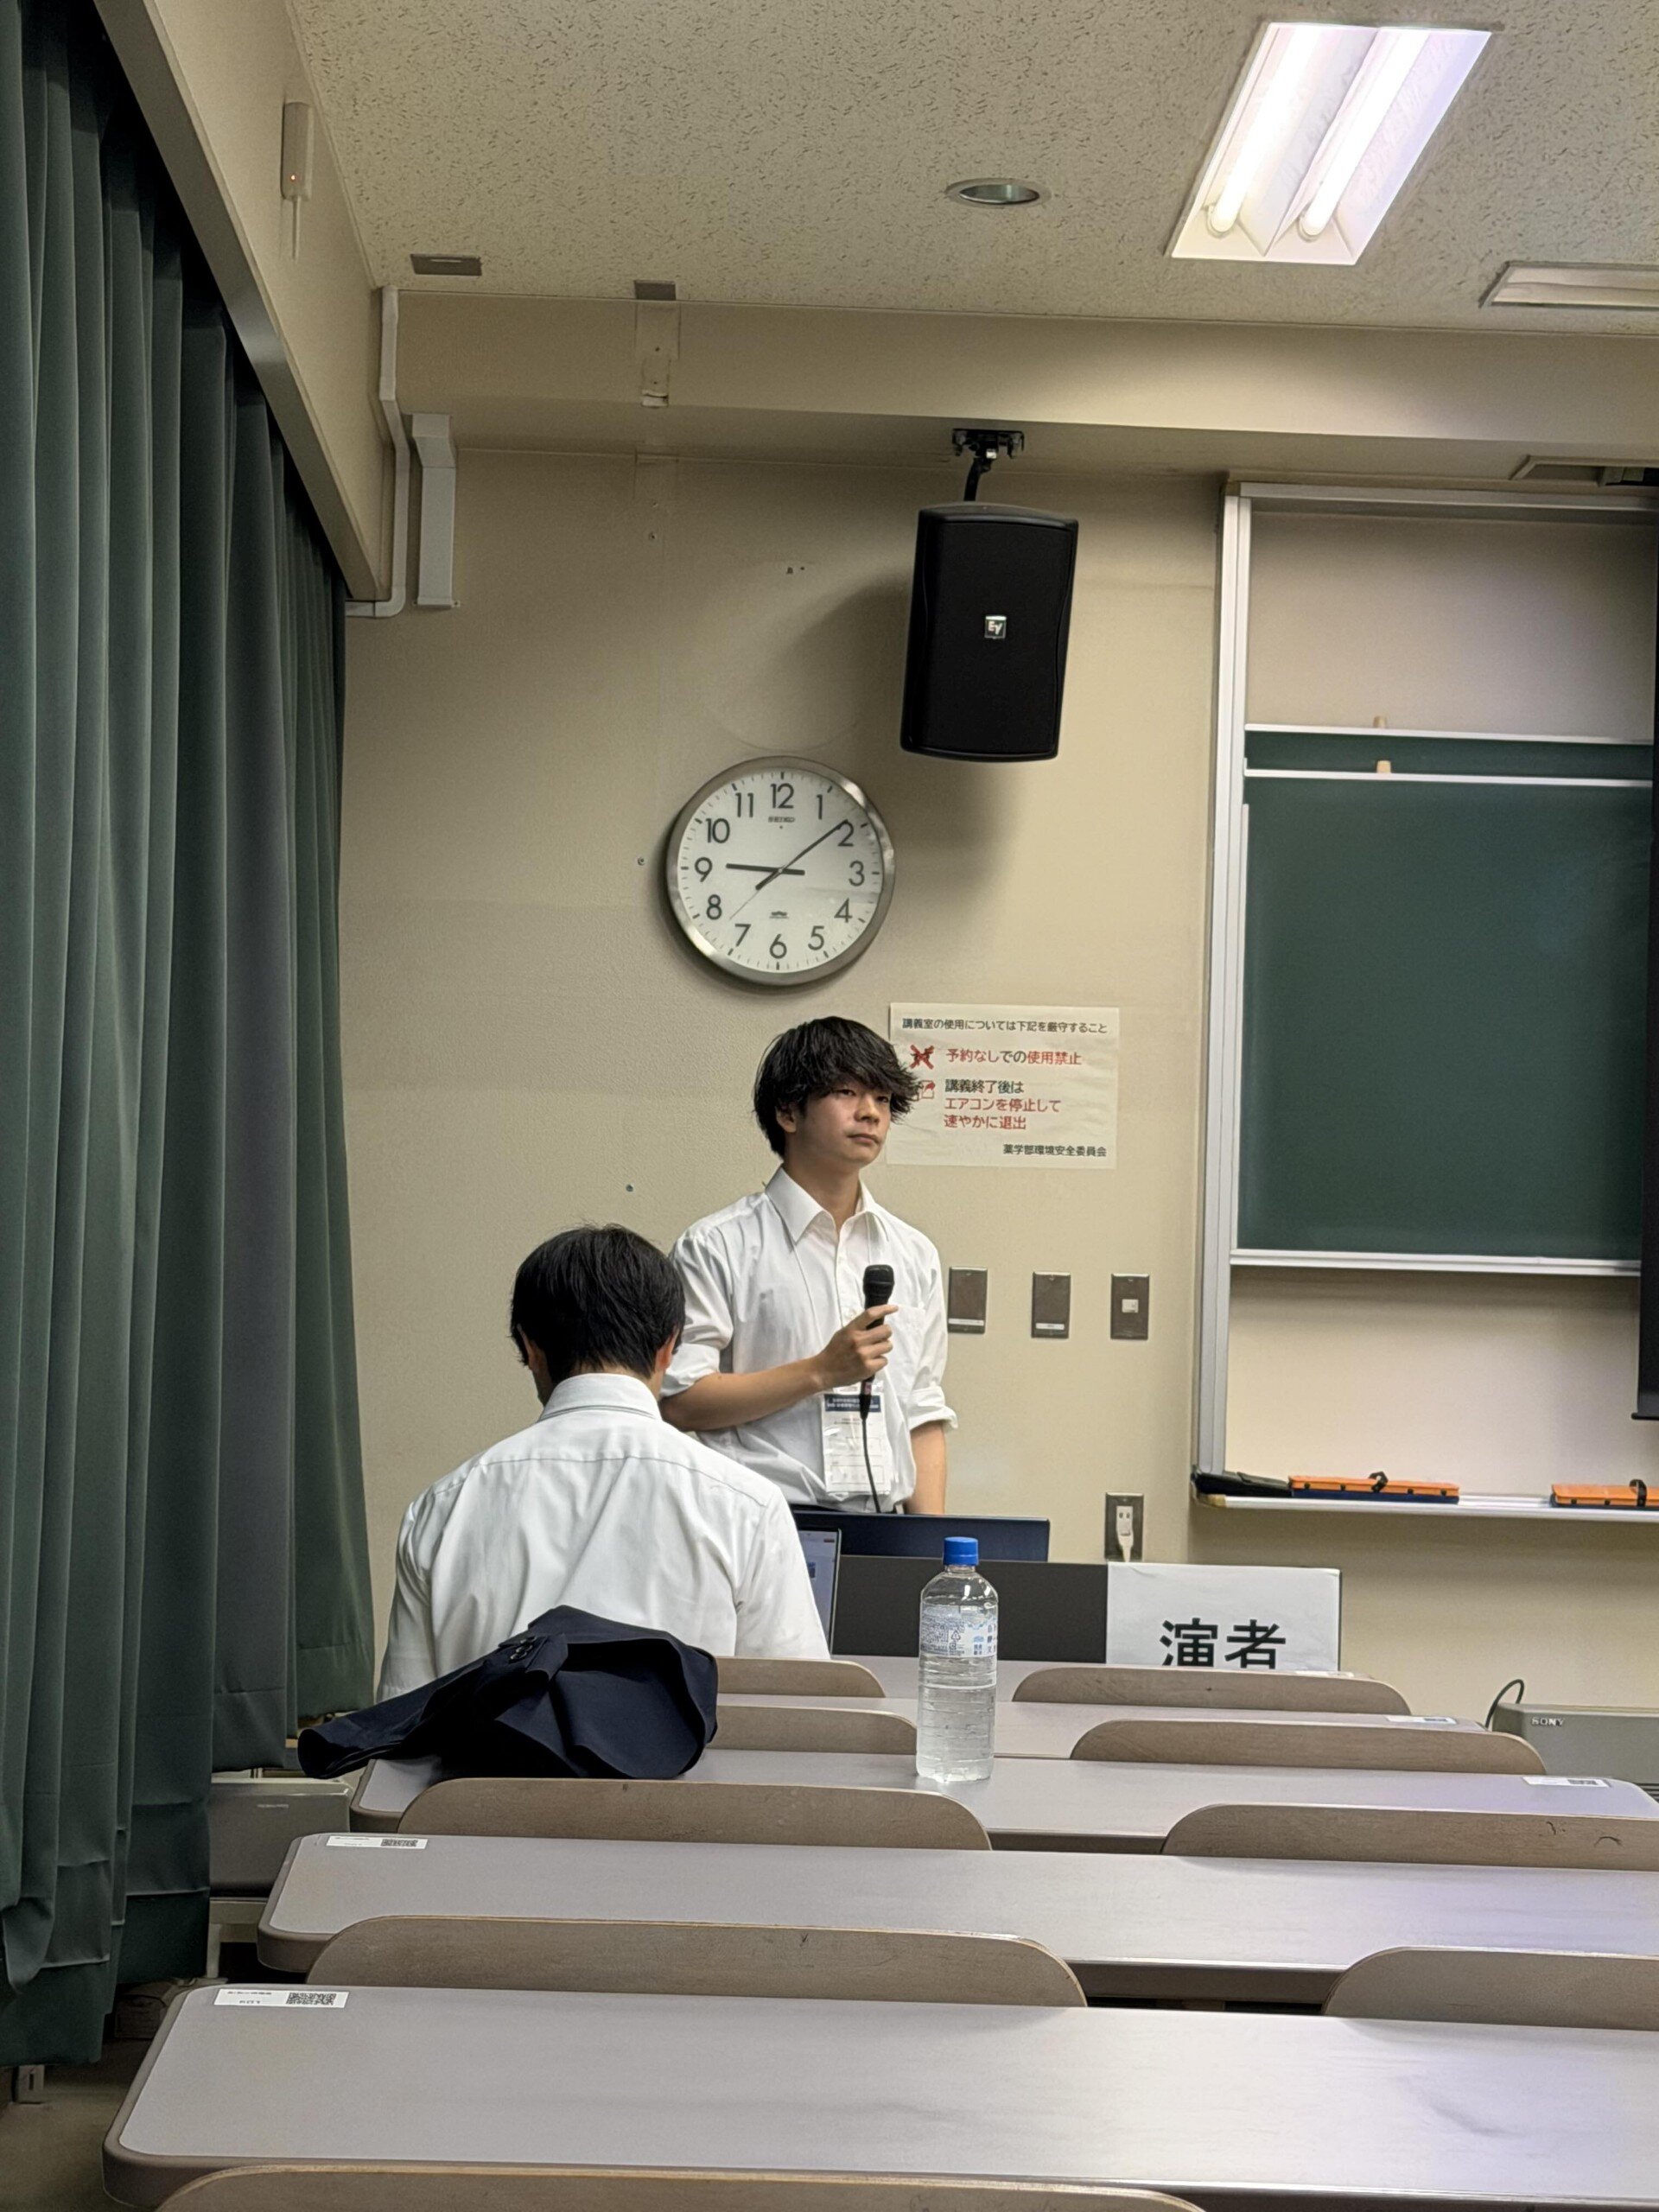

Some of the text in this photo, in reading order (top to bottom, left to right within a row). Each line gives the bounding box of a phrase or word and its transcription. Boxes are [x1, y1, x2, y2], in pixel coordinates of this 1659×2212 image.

[735, 792, 753, 817] 11
[771, 783, 794, 809] 12
[817, 794, 823, 820] 1
[706, 818, 730, 843] 10
[837, 820, 855, 847] 2
[695, 857, 713, 882] 9
[849, 861, 865, 887] 3
[706, 894, 722, 920] 8
[834, 898, 853, 923] 4
[734, 923, 752, 947] 7
[769, 934, 787, 959] 6
[808, 925, 824, 950] 5
[902, 1018, 1108, 1033] 講義室の使用については下記を厳守すること
[946, 1048, 1082, 1065] 予約なしでの使用禁止
[944, 1078, 1025, 1094] 講義終了後は
[944, 1097, 1061, 1113] エアコンを停止して
[944, 1115, 1027, 1130] 速やかに退出
[1003, 1143, 1107, 1157] 薬学部環境安全委員会
[1160, 1618, 1286, 1669] 演者
[1531, 1716, 1564, 1726] SONY
